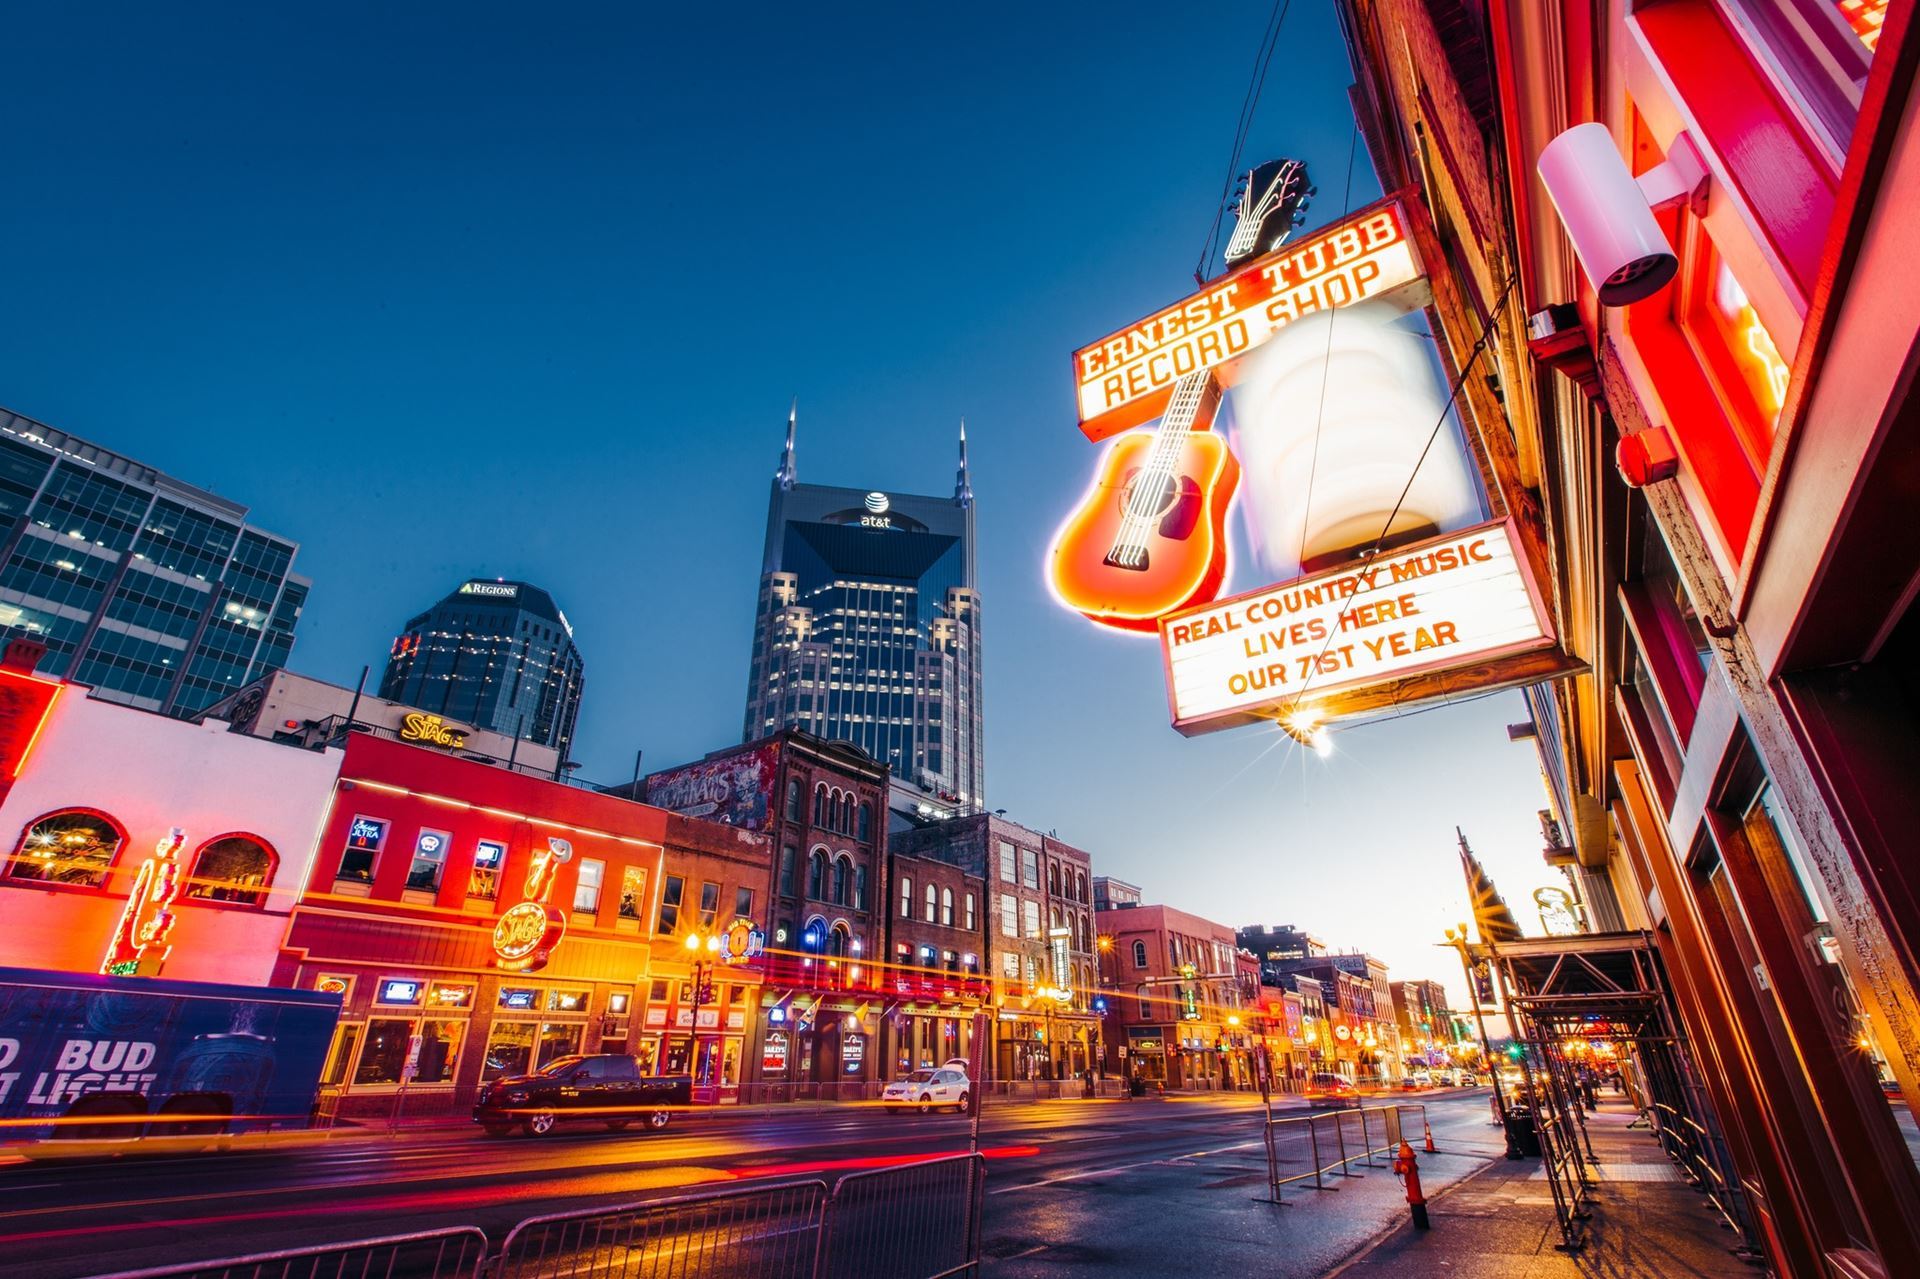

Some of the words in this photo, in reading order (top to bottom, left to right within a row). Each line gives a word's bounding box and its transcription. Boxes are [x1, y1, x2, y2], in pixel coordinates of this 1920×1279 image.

[1081, 283, 1239, 382] ERNEST
[1263, 213, 1398, 293] TUBB
[1104, 318, 1250, 408] RECORD
[1266, 260, 1380, 332] SHOP
[861, 516, 890, 528] at&t
[473, 584, 515, 596] REGIONS
[1174, 613, 1242, 646] REAL
[1246, 568, 1380, 624] COUNTRY
[1390, 540, 1493, 583] MUSIC
[1244, 618, 1327, 658] LIVES
[1339, 593, 1420, 632] HERE
[1228, 664, 1288, 694] OUR
[1296, 644, 1355, 680] 71ST
[1363, 621, 1460, 661] YEAR
[494, 914, 544, 949] STAGE
[56, 1040, 156, 1071] BUD
[28, 1072, 157, 1104] LIGHT
